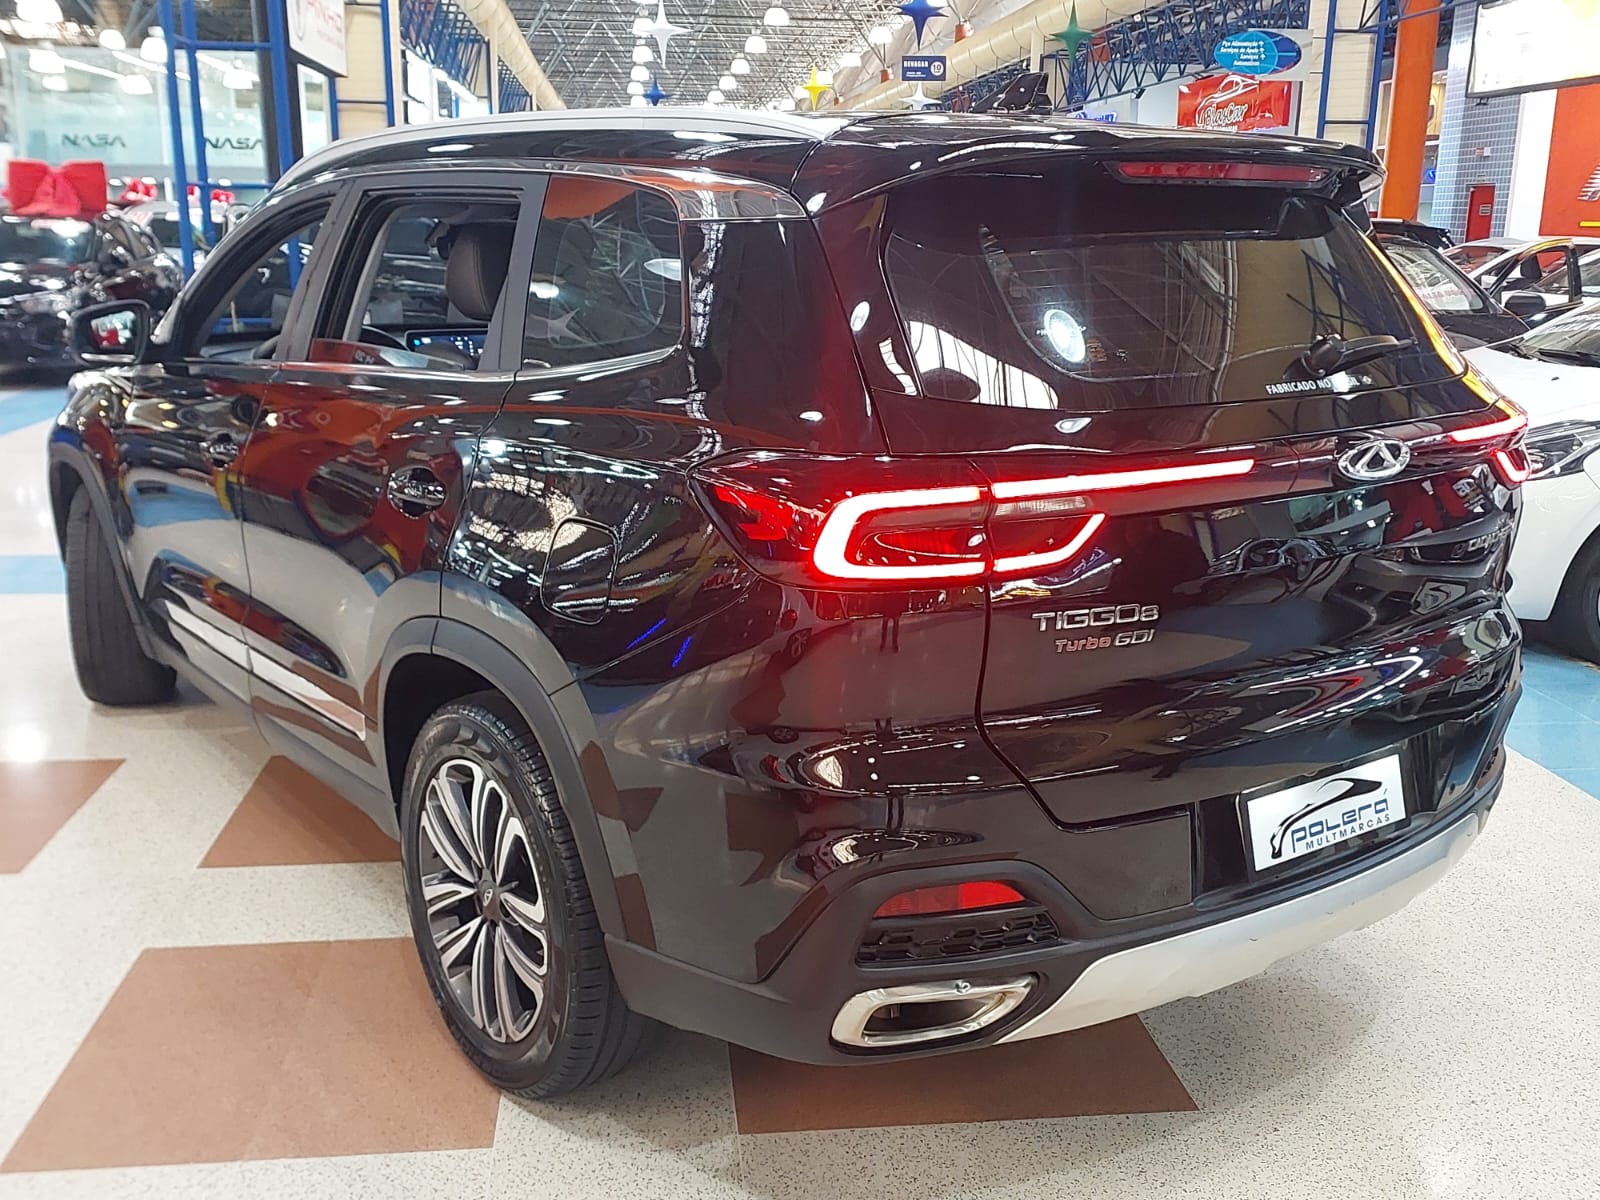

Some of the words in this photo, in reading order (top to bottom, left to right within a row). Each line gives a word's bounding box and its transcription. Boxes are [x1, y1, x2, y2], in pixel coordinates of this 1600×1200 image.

[62, 134, 126, 148] NASA
[1265, 380, 1317, 395] FABRICADO
[1317, 378, 1331, 389] NO
[1055, 636, 1111, 653] Turbo
[1114, 629, 1156, 647] GDI
